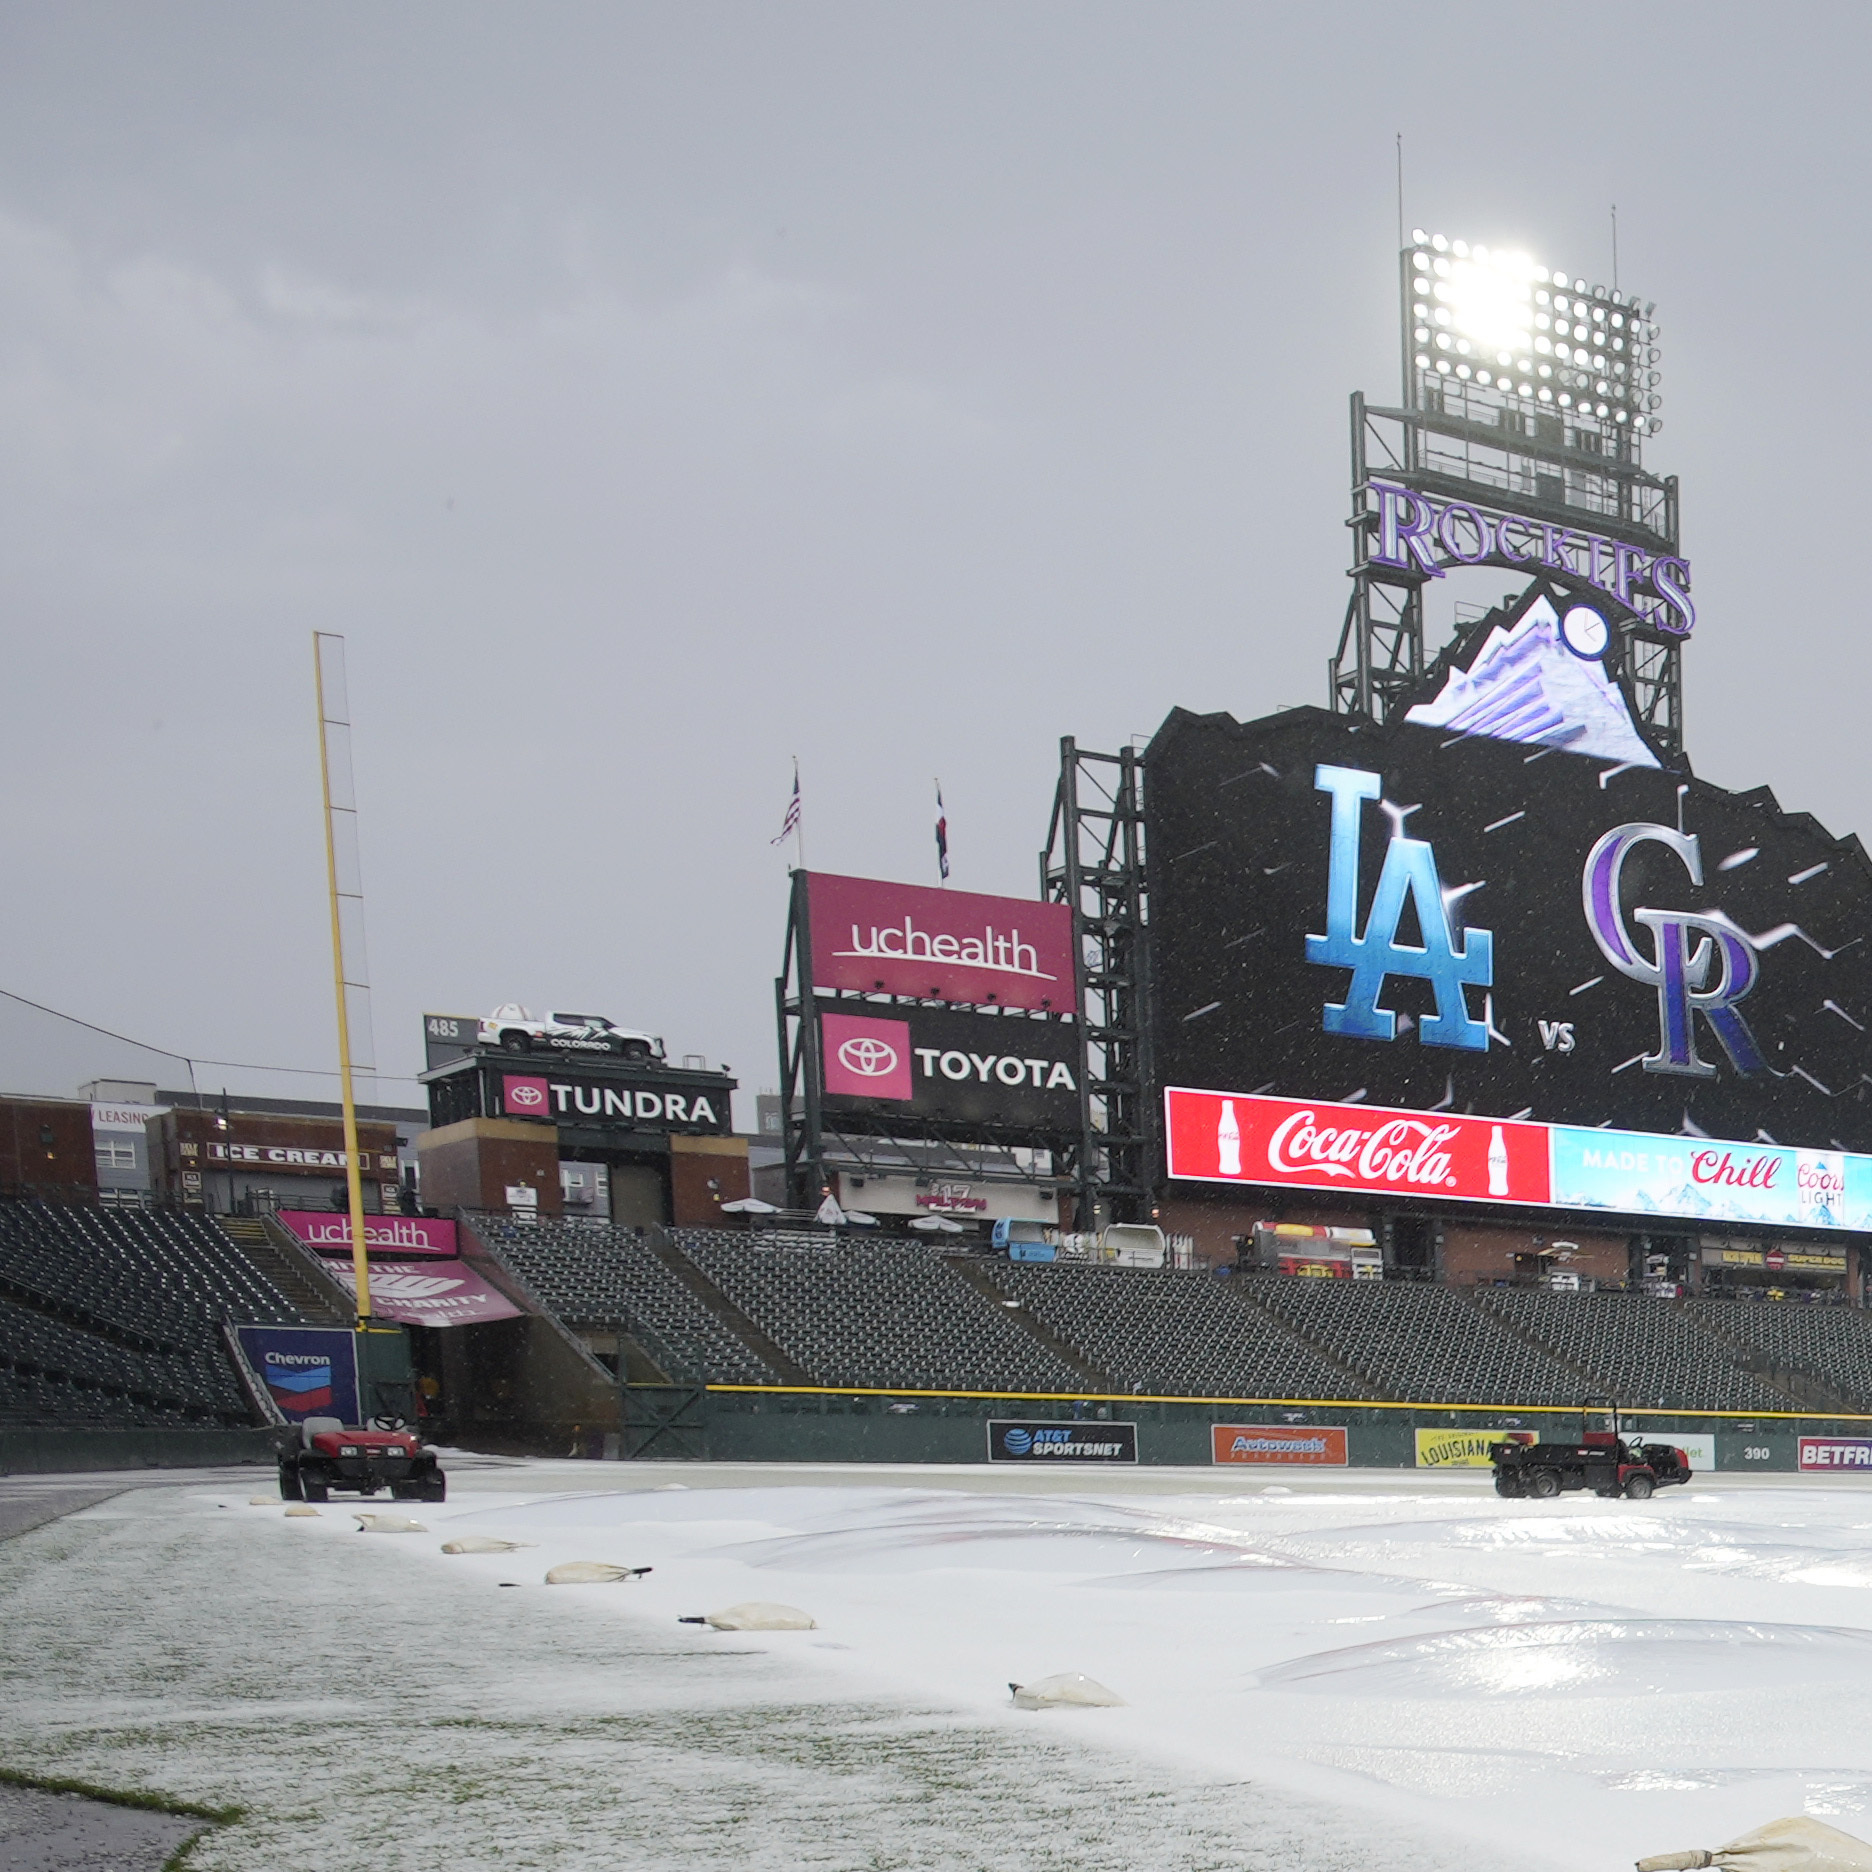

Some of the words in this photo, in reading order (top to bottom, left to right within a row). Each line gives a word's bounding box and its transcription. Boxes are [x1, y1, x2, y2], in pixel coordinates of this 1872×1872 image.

[1369, 481, 1696, 636] ROCKIES
[1306, 764, 1493, 1053] LA
[852, 916, 1038, 973] uchealth
[429, 1019, 458, 1037] 485
[551, 1038, 611, 1051] COLORADO
[915, 1048, 1076, 1092] TOYOTA
[551, 1084, 717, 1125] TUNDRA
[216, 1146, 262, 1161] ICE
[1268, 1110, 1461, 1185] Coca-Cola
[1583, 1149, 1649, 1173] MADE
[1691, 1150, 1782, 1189] Chill
[1801, 1191, 1843, 1206] LIGHT
[308, 1219, 428, 1247] uchealth
[265, 1352, 330, 1365] Chevron
[1032, 1430, 1072, 1443] AT&T
[1032, 1442, 1123, 1457] SPORTSNET
[1744, 1446, 1770, 1461] 390
